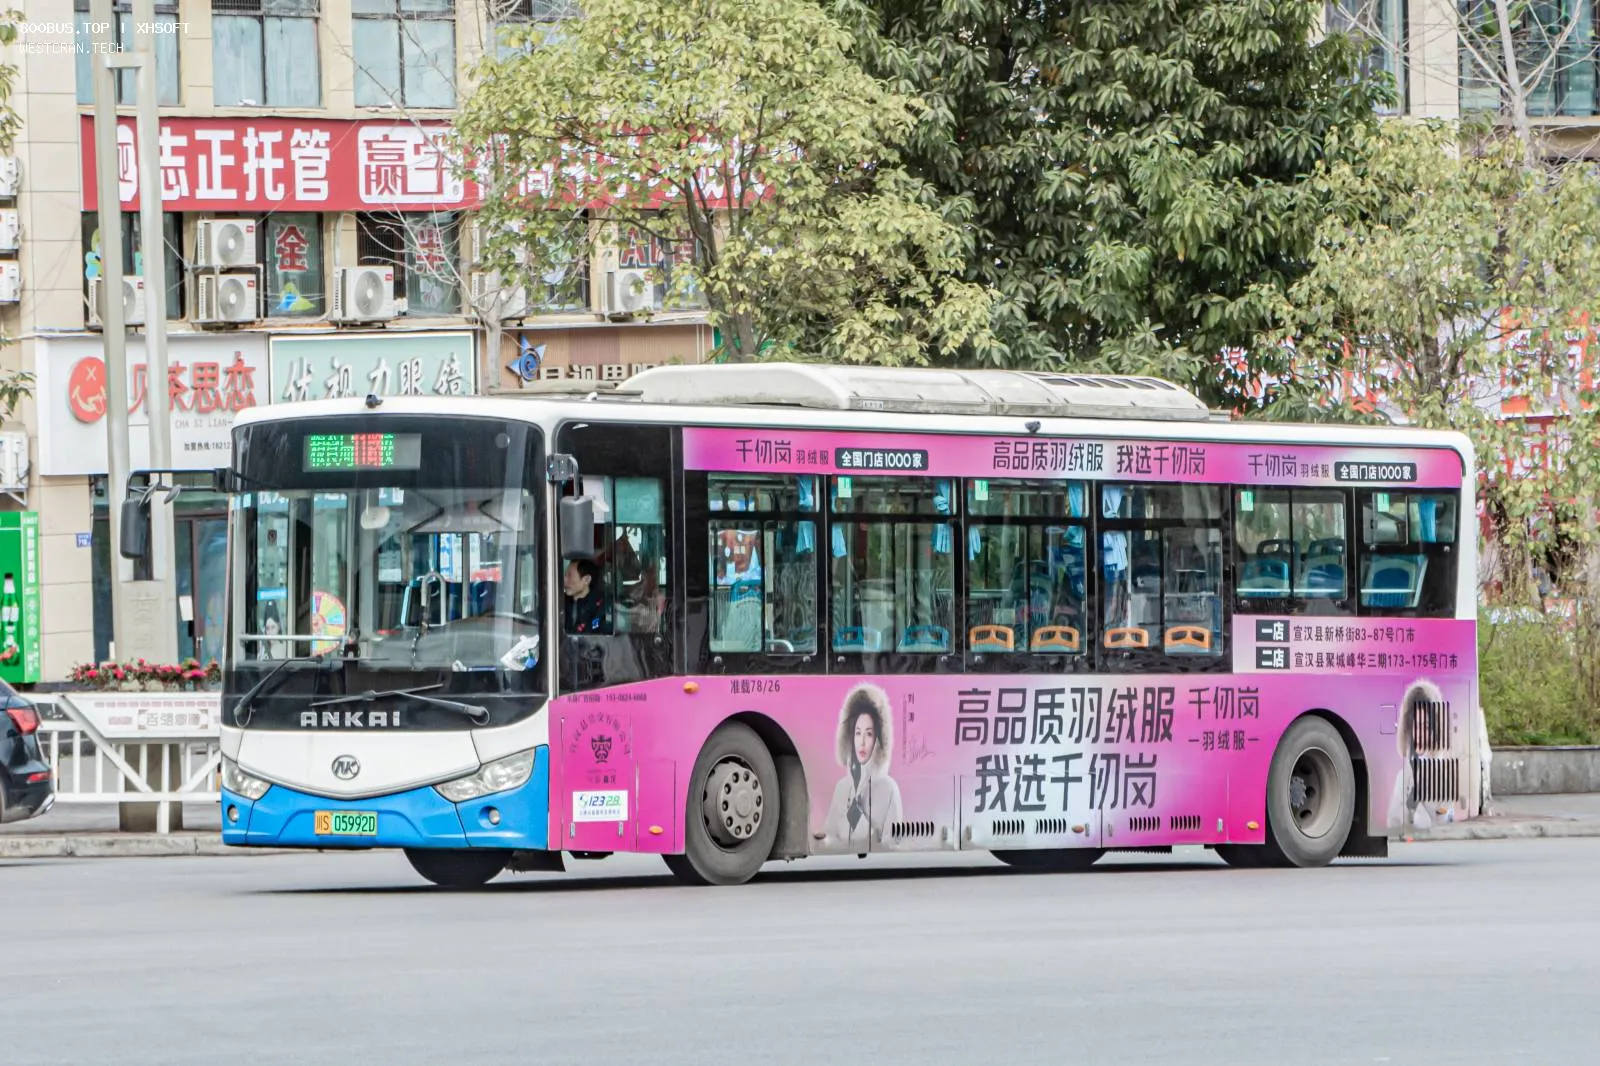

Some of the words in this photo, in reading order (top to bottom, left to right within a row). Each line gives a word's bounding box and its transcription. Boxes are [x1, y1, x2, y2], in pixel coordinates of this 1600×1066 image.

[736, 439, 792, 465] 千仞岗
[795, 449, 830, 465] 羽绒服
[841, 450, 923, 469] 全国门店1000家
[993, 441, 1104, 472] 高品质羽绒服
[1116, 444, 1206, 476] 我选千仞岗
[1247, 453, 1298, 478] 千仞岗
[1339, 464, 1412, 481] 全国门店1000家
[1261, 621, 1285, 642] 一店
[1261, 649, 1285, 669] 二店
[730, 680, 781, 695] 准载78/26
[1188, 686, 1260, 719] 千仞岗
[300, 711, 400, 728] ANKAI
[954, 687, 1175, 746] 高品质羽绒服
[974, 752, 1158, 814] 我选千仞岗
